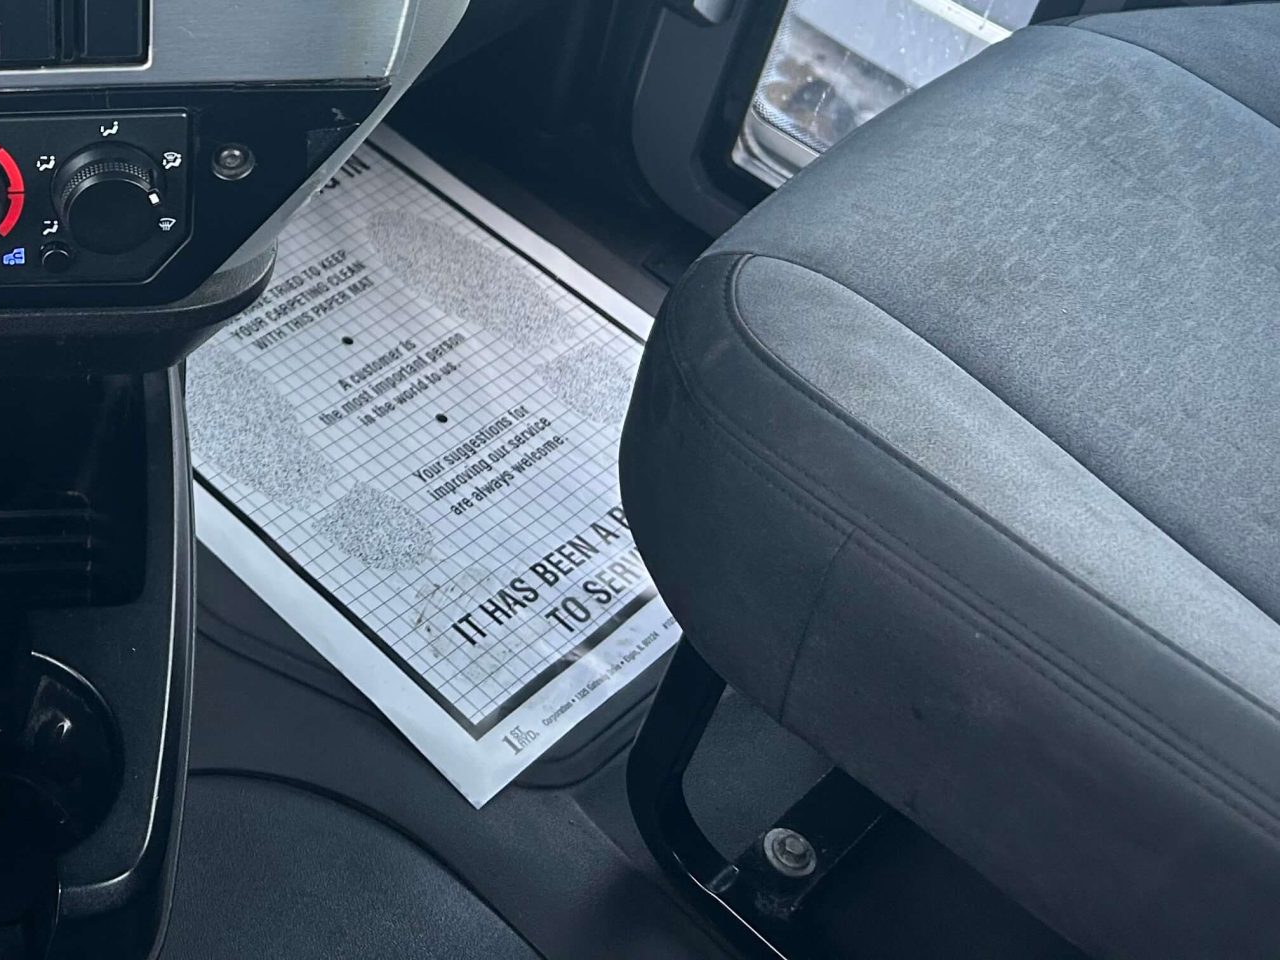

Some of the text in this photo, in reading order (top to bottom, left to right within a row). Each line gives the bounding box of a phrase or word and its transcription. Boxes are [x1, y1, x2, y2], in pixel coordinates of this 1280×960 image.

[230, 259, 367, 340] YOUR CARPETING CLEAN
[301, 265, 320, 281] TO
[320, 248, 348, 270] KEEP
[252, 275, 375, 351] WITH THIS PAPER MAT
[318, 332, 466, 427] the most important person
[337, 339, 417, 391] A customer is
[357, 413, 377, 427] in
[371, 399, 396, 418] the
[393, 377, 430, 406] world
[423, 371, 442, 386] to
[412, 404, 530, 484] Your suggestions for
[426, 416, 552, 502] improving our service
[450, 434, 569, 516] are always welcome.
[451, 612, 487, 647] IT
[478, 576, 539, 626] HAS
[529, 534, 600, 588] BEEN
[590, 522, 620, 546] A
[544, 596, 591, 633] TO
